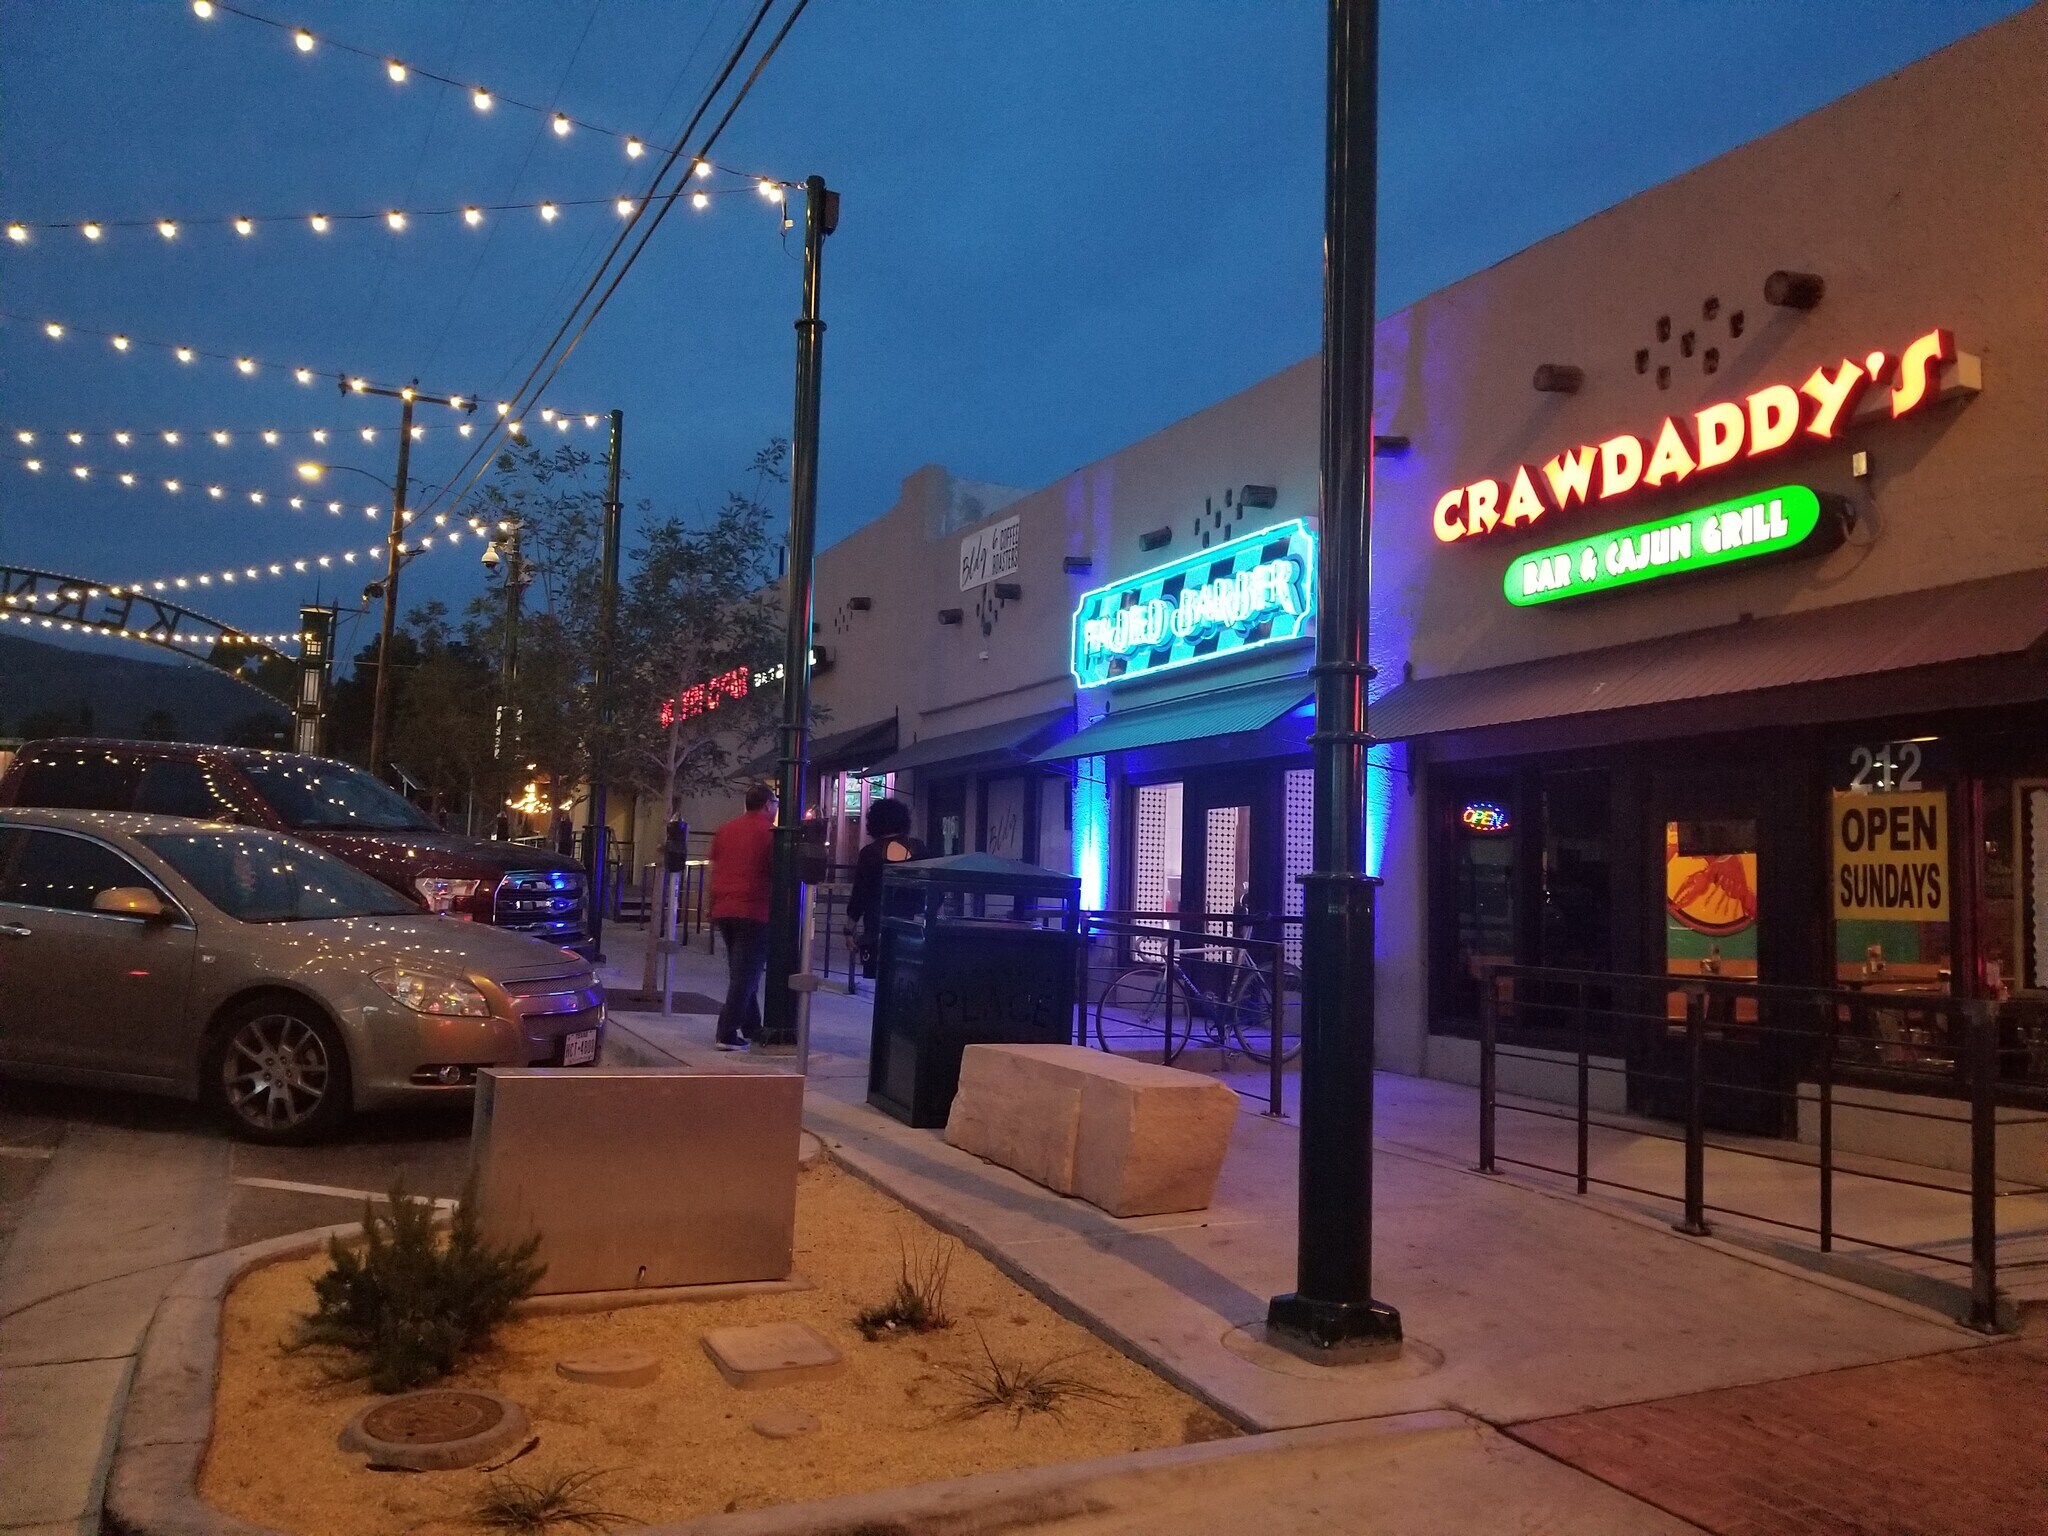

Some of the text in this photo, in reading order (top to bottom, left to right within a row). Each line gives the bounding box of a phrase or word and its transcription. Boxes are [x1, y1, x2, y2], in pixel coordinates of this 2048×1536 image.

[1432, 327, 1948, 544] CRAWDADDY'S
[991, 545, 1019, 576] ROASTERS
[1000, 523, 1020, 551] COFFEE
[1522, 498, 1789, 595] BAR & CAJUN GRILL
[1849, 743, 1923, 792] 212
[1462, 808, 1505, 828] OPEN
[1840, 805, 1938, 853] OPEN
[1840, 862, 1942, 910] SUNDAYS
